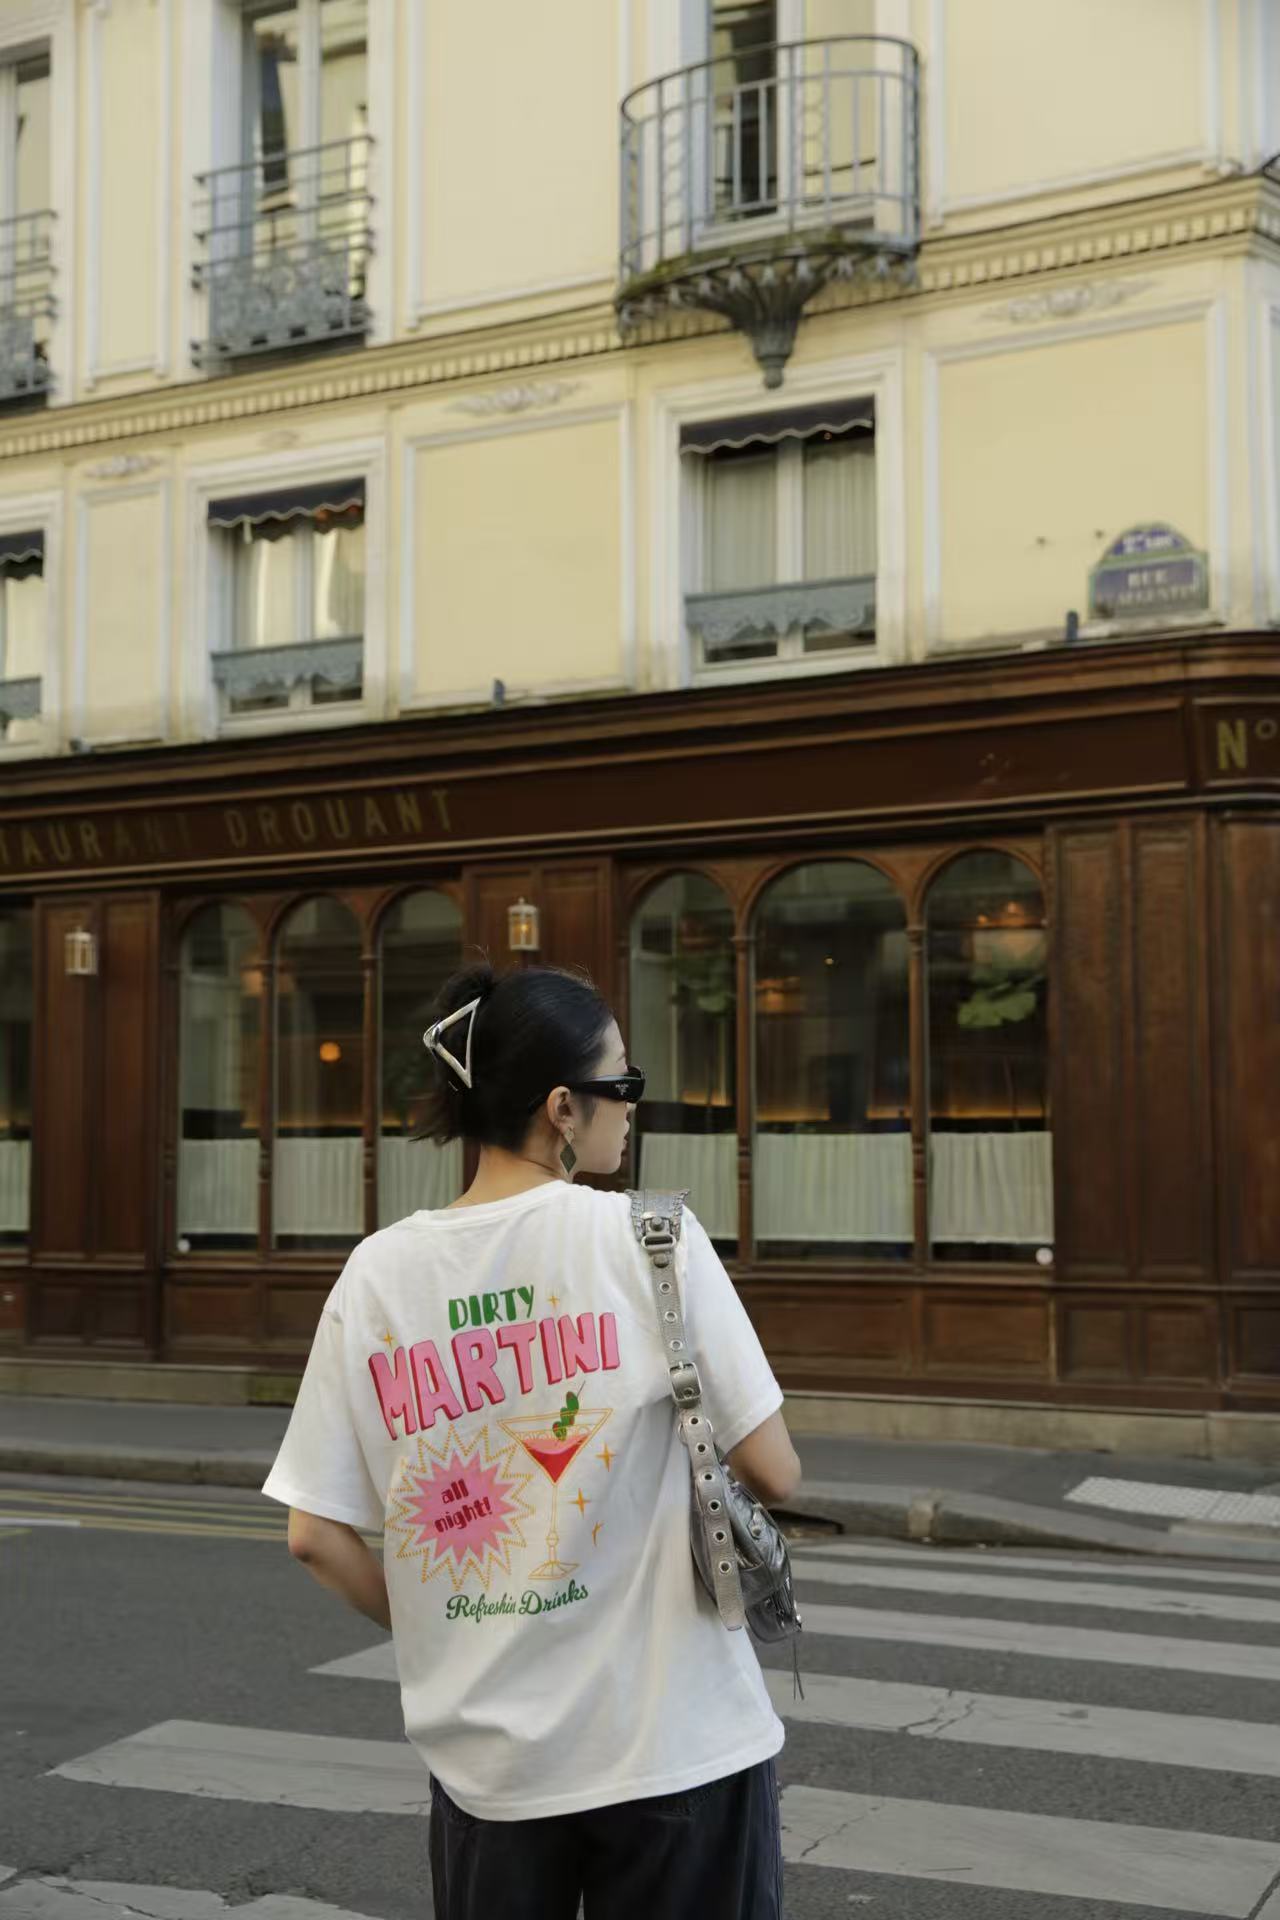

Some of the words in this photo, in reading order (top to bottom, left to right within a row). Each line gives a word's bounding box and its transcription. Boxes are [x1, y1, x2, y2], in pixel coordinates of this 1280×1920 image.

[223, 788, 452, 849] DROUANT
[448, 1285, 534, 1331] DIRTY
[368, 1312, 621, 1441] MARTINI
[441, 1478, 469, 1505] all
[434, 1496, 493, 1533] night!
[518, 1578, 589, 1615] Drinks
